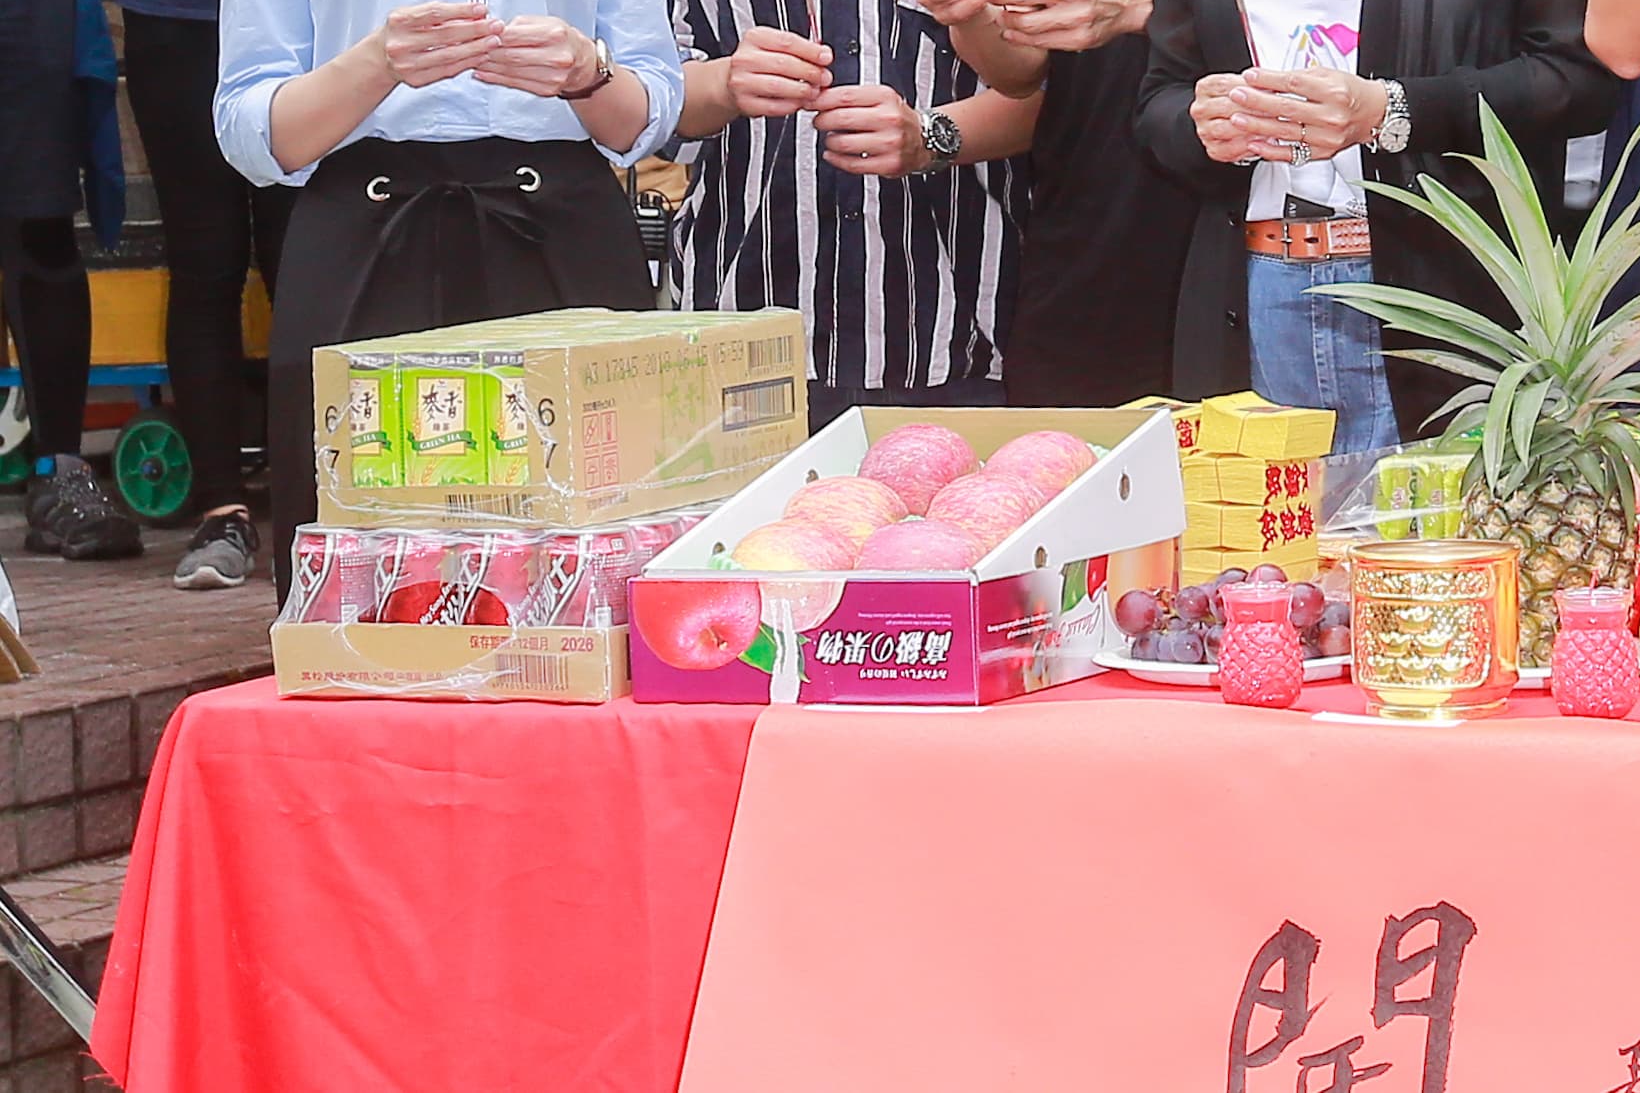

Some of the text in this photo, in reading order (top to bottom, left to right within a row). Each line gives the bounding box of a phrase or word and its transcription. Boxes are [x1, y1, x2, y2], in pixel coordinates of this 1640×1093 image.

[420, 384, 463, 422] 麥香
[538, 397, 556, 427] 6
[325, 405, 338, 433] 6
[420, 437, 445, 450] GREEN
[815, 631, 952, 665] 高級の果物
